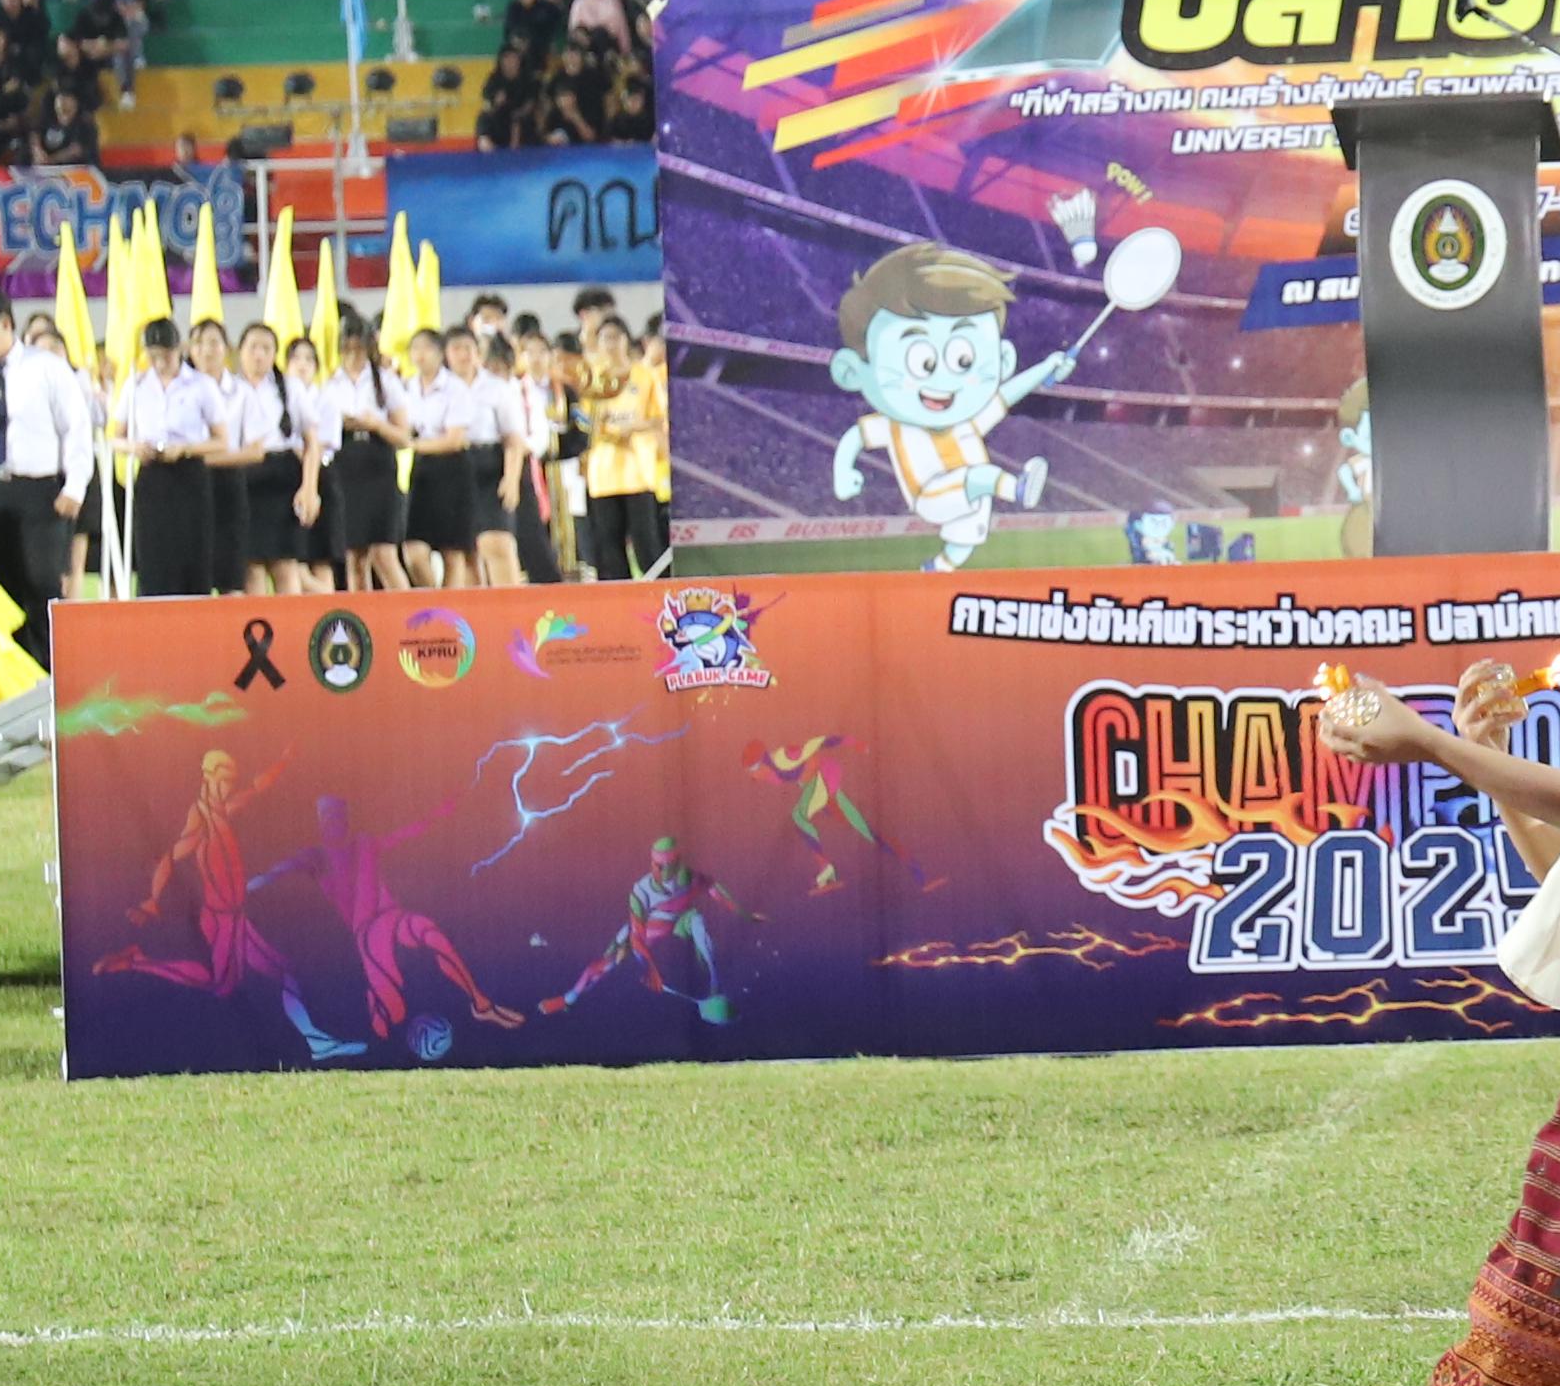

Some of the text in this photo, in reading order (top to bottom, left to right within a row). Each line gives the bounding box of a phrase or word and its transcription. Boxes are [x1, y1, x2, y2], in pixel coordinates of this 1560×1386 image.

[1282, 280, 1313, 304] ณ
[784, 521, 888, 539] BUSINESS
[952, 590, 1414, 645] การแข่งขันกีฬาระหว่างคณะ
[417, 645, 458, 659] KPRU
